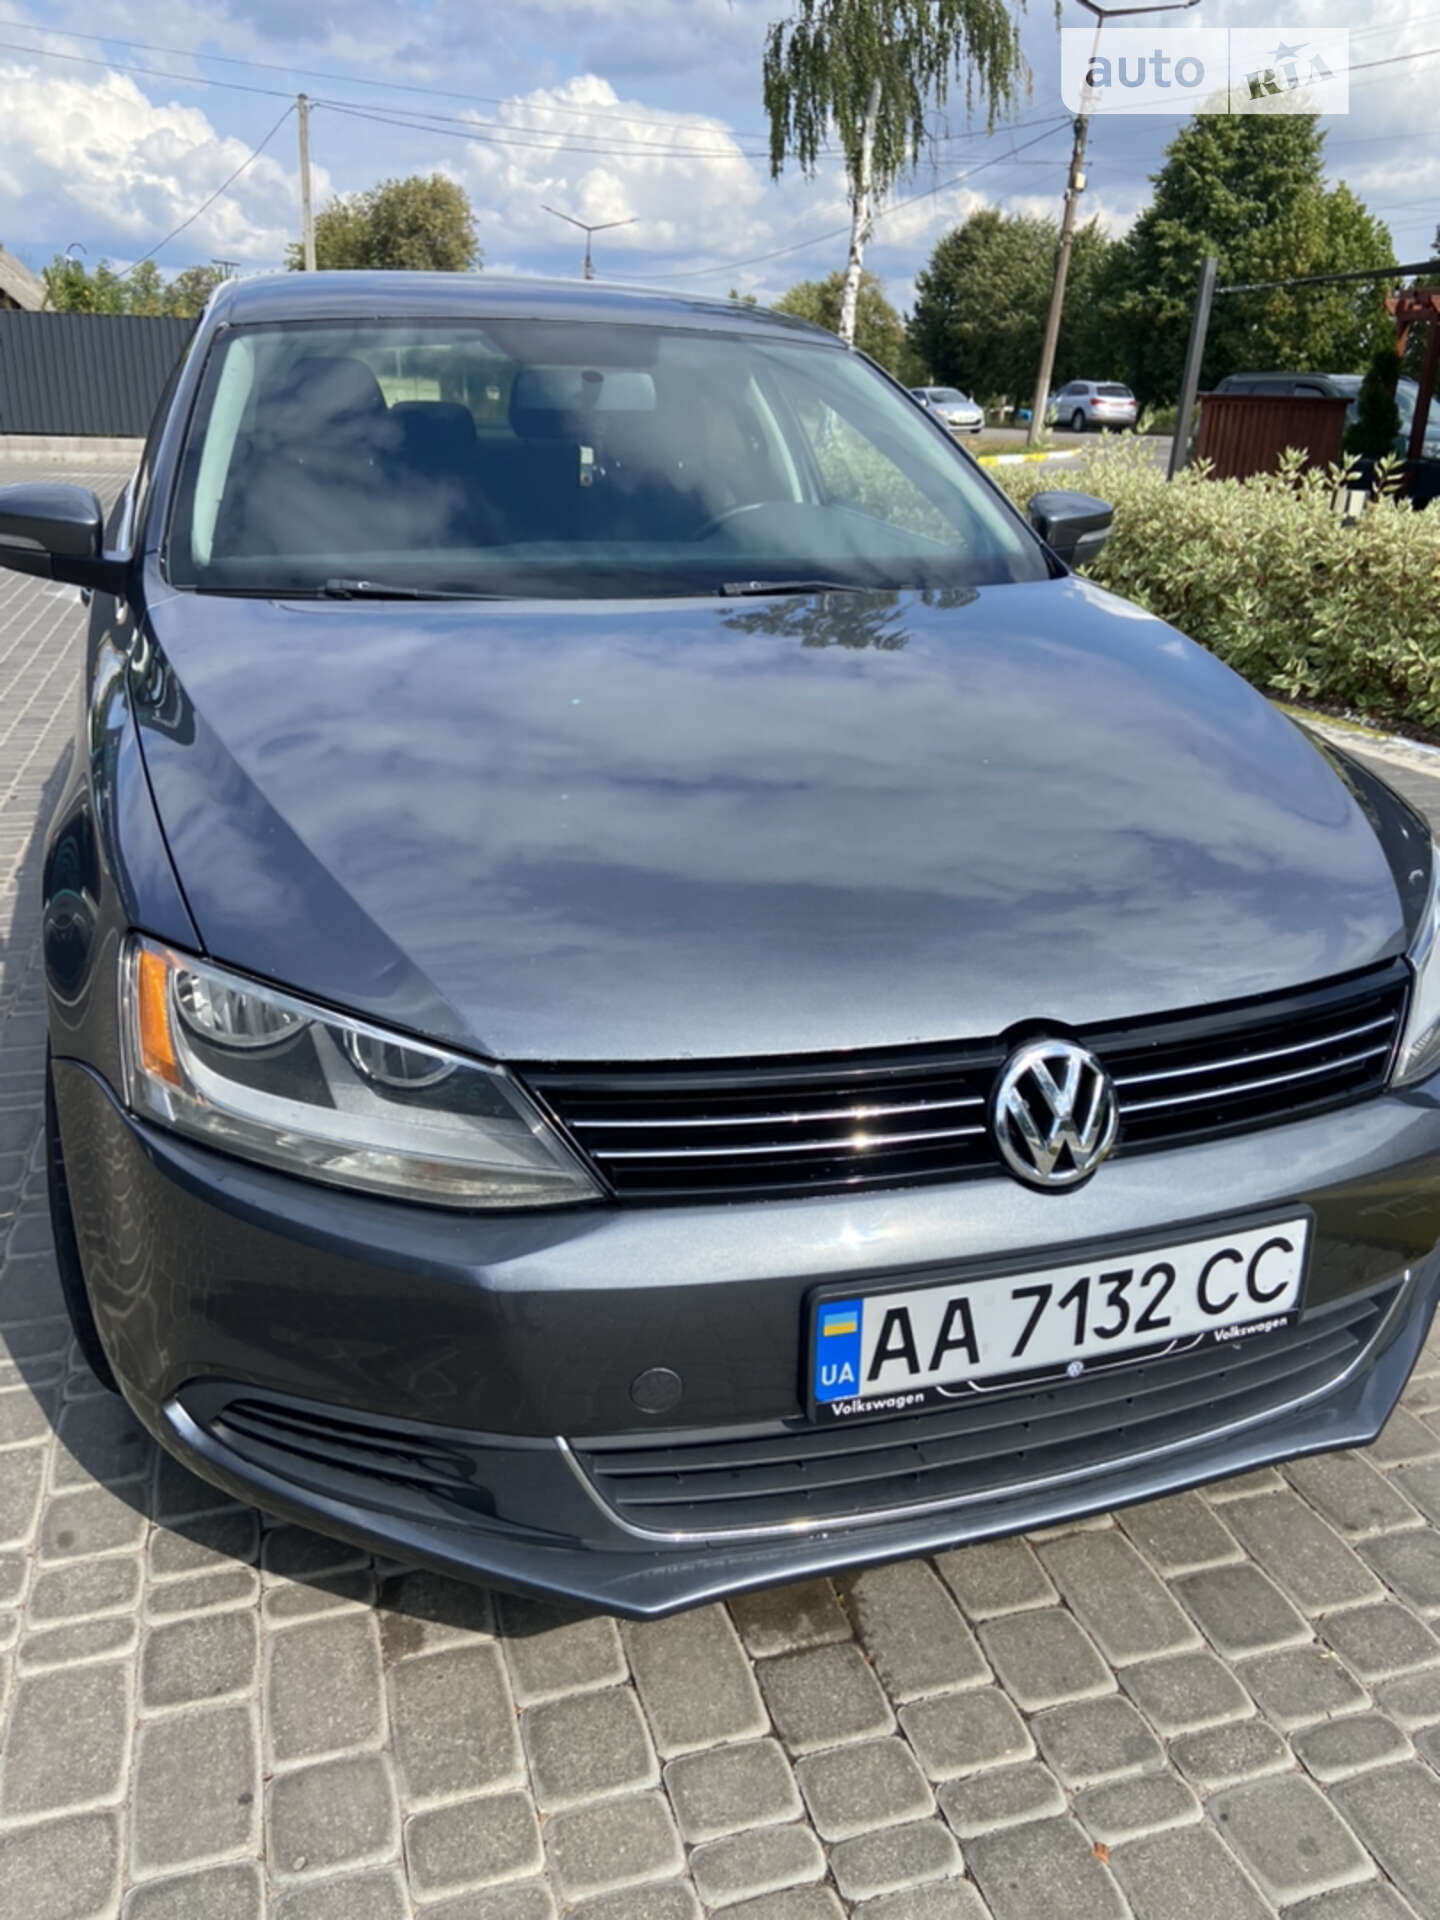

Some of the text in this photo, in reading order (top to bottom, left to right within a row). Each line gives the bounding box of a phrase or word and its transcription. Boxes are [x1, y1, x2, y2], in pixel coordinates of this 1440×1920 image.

[867, 1236, 1294, 1382] AA 7132 CC
[1214, 1316, 1288, 1343] Volkswagen
[821, 1362, 855, 1386] UA
[831, 1392, 925, 1417] Volkswagen
